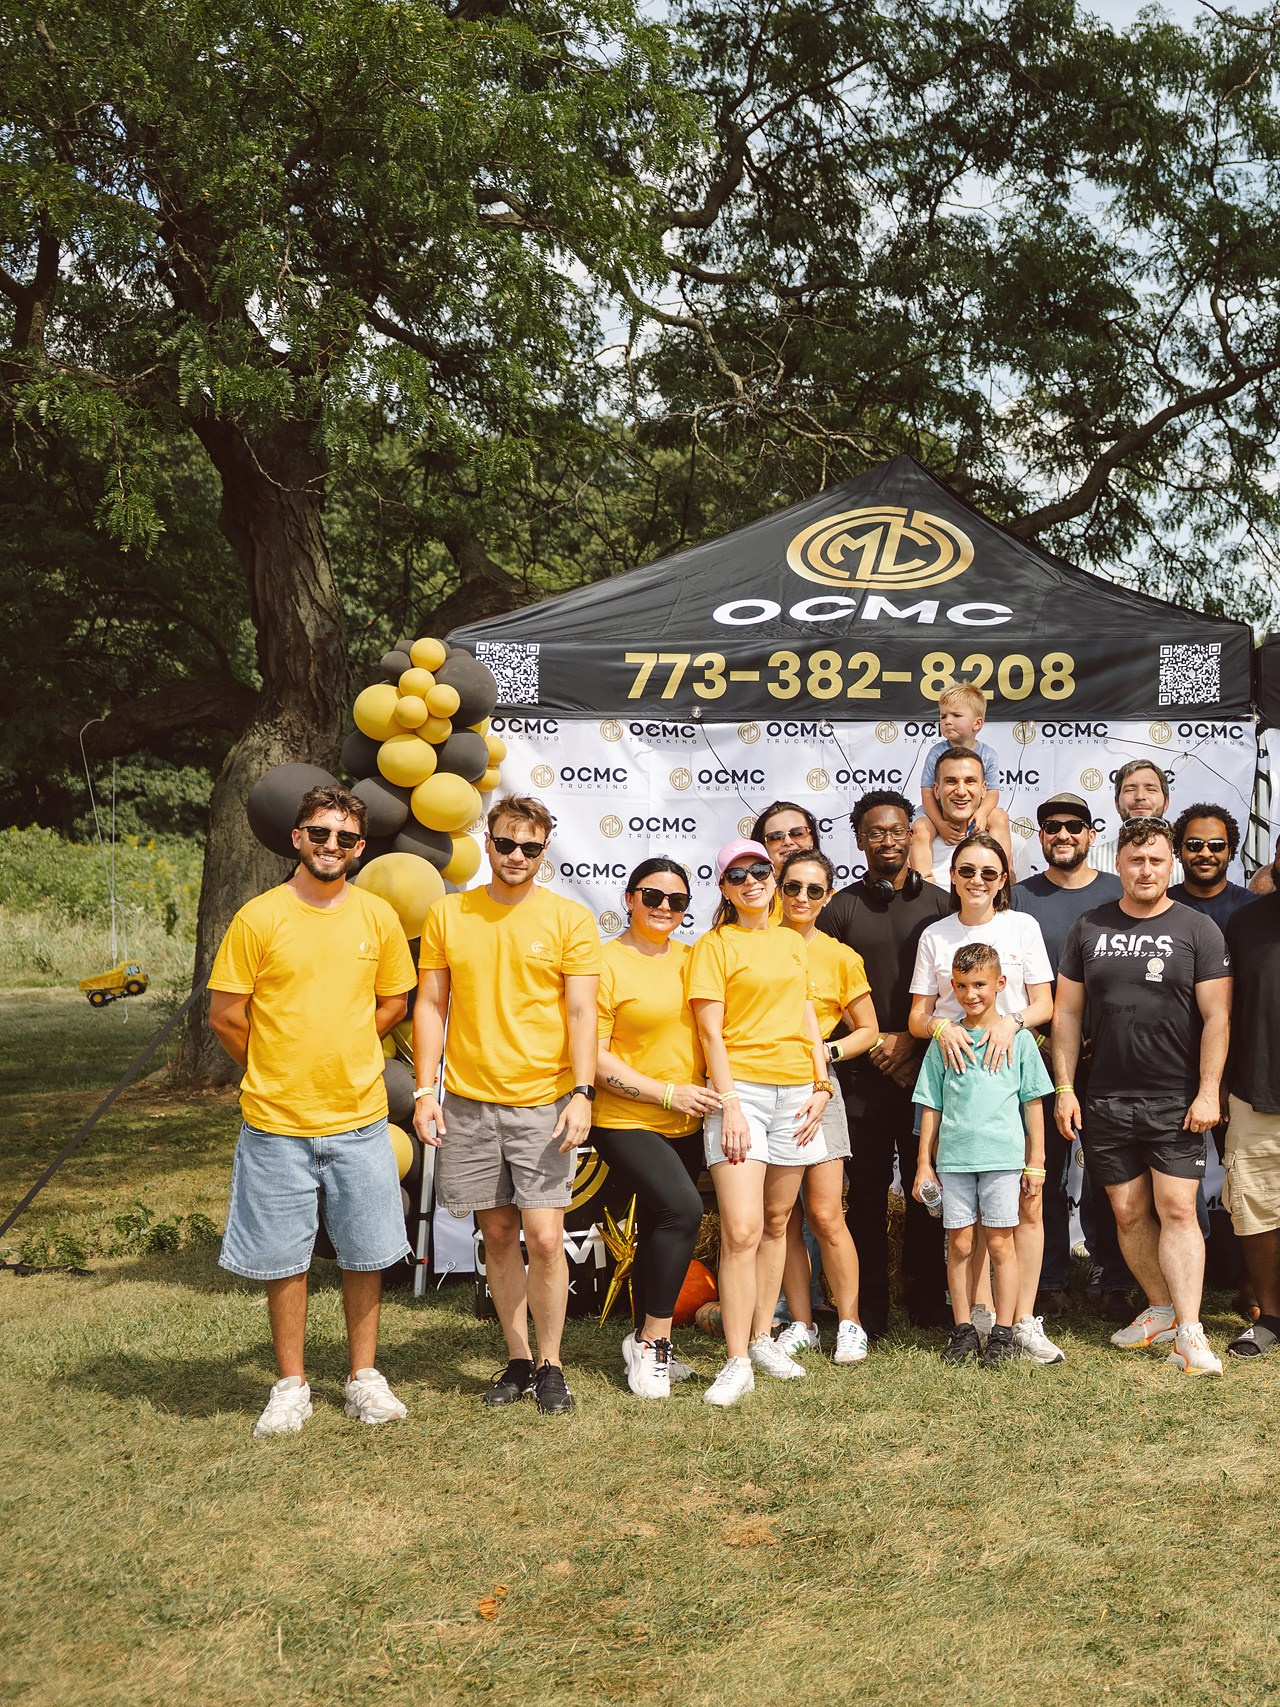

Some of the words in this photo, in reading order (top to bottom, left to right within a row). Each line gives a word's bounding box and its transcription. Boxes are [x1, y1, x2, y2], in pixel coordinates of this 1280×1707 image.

[713, 595, 1013, 626] OCMC
[625, 651, 1076, 701] 773-382-8208
[490, 717, 559, 734] OCMC
[629, 722, 696, 738] OCMC
[767, 721, 835, 737] OCMC
[904, 721, 942, 738] OC
[1042, 722, 1108, 738] OCMC
[1177, 722, 1244, 739] OCMC
[560, 766, 628, 782] OCMC
[697, 768, 765, 784] OCMC
[835, 769, 902, 784] OCMC
[628, 816, 697, 832] OCMC
[560, 862, 627, 879] OCMC
[560, 878, 627, 886] TRUCKING
[1094, 933, 1173, 952] ASICS
